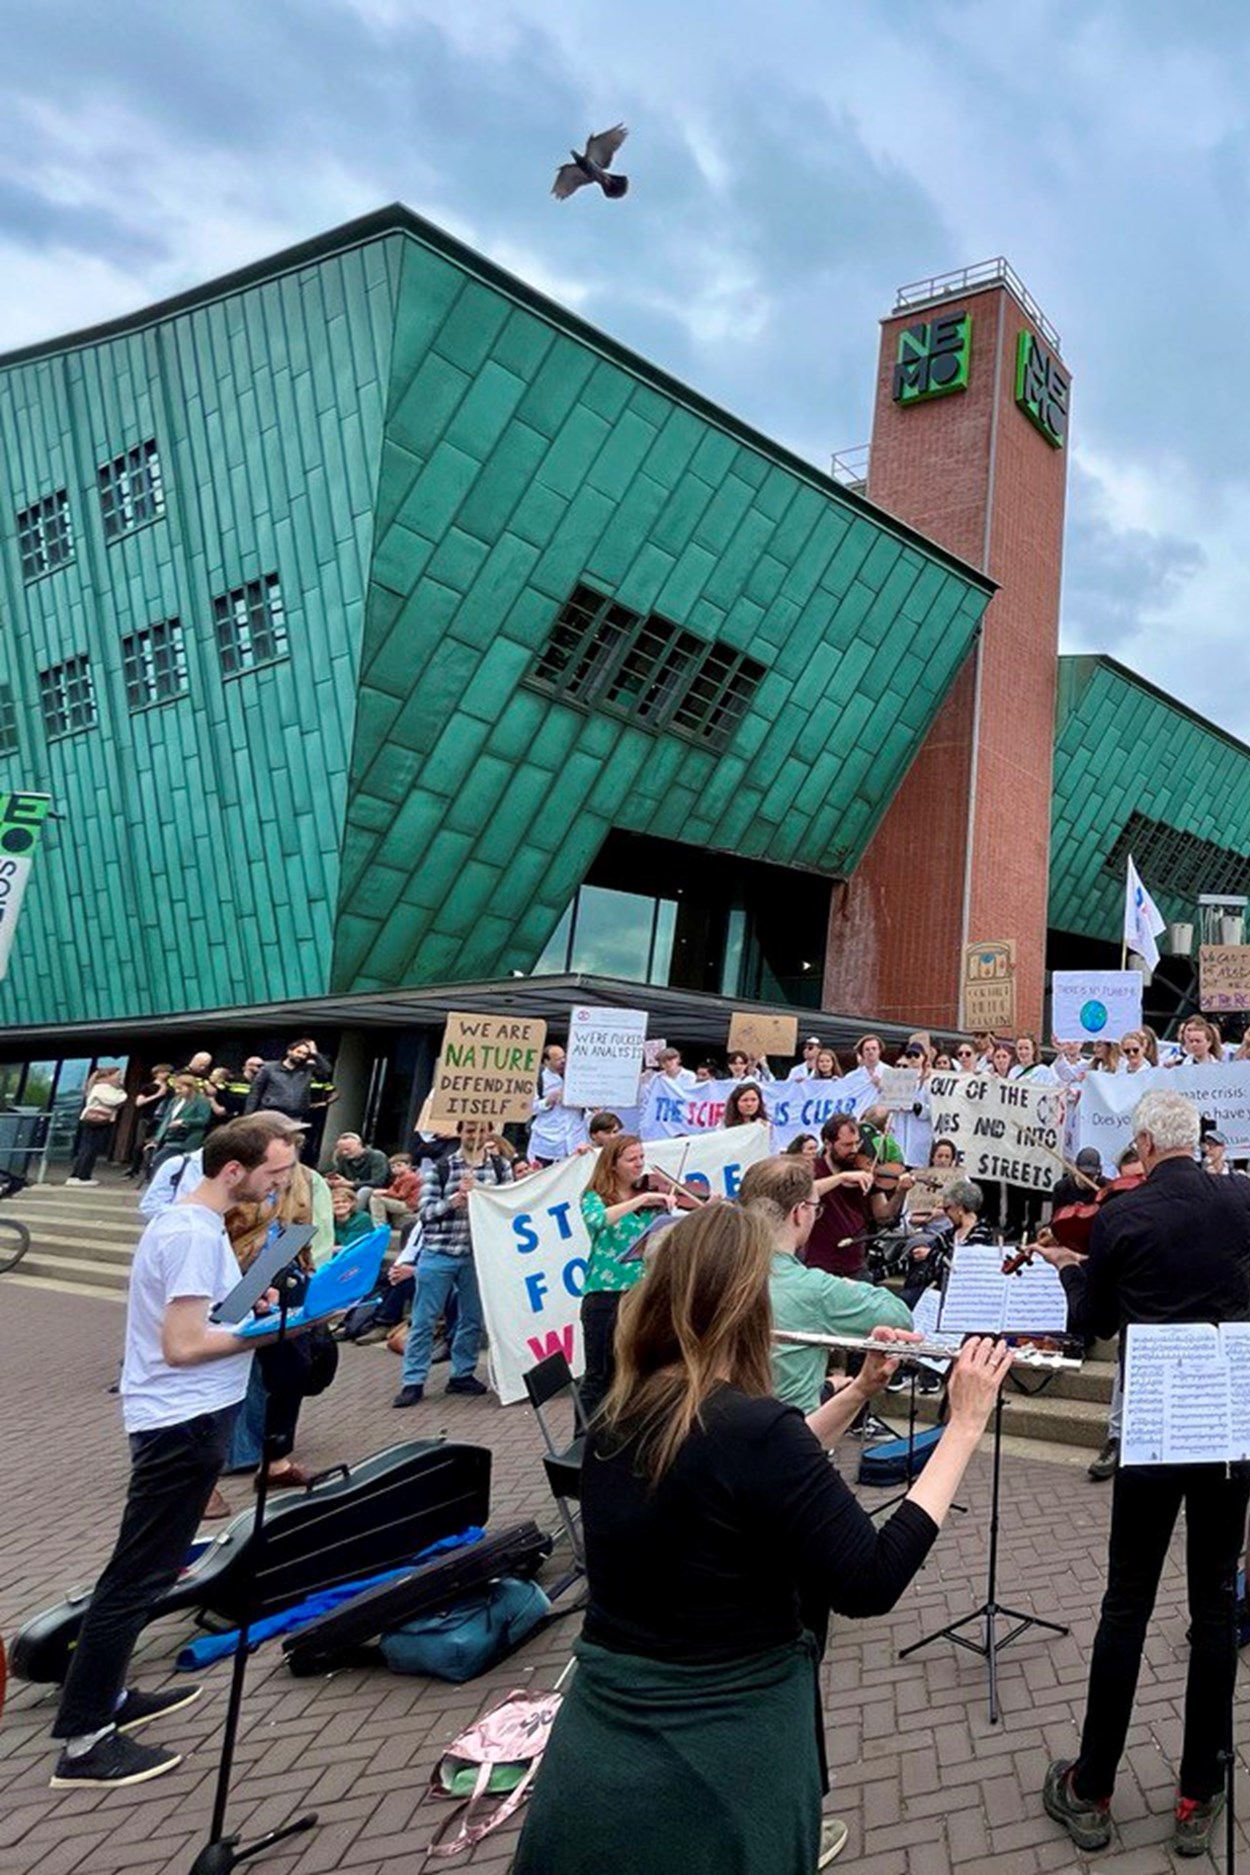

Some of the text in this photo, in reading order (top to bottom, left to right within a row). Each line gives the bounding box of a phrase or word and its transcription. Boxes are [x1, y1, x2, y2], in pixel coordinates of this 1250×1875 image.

[2, 793, 51, 826] E
[460, 1021, 531, 1040] WE ARE
[445, 1043, 538, 1072] NATURE
[572, 1045, 587, 1056] AN
[440, 1075, 534, 1095] DEFENDING
[930, 1076, 960, 1097] OUT
[965, 1080, 988, 1103] OF
[1000, 1084, 1029, 1108] THE
[1212, 1088, 1247, 1099] crisis:
[446, 1097, 512, 1115] ITSELF
[656, 1097, 684, 1122] THE
[774, 1099, 790, 1126] IS
[1213, 1106, 1248, 1120] have
[974, 1117, 1006, 1139] AND
[1016, 1126, 1057, 1149] INTO
[978, 1153, 1053, 1188] STREETS
